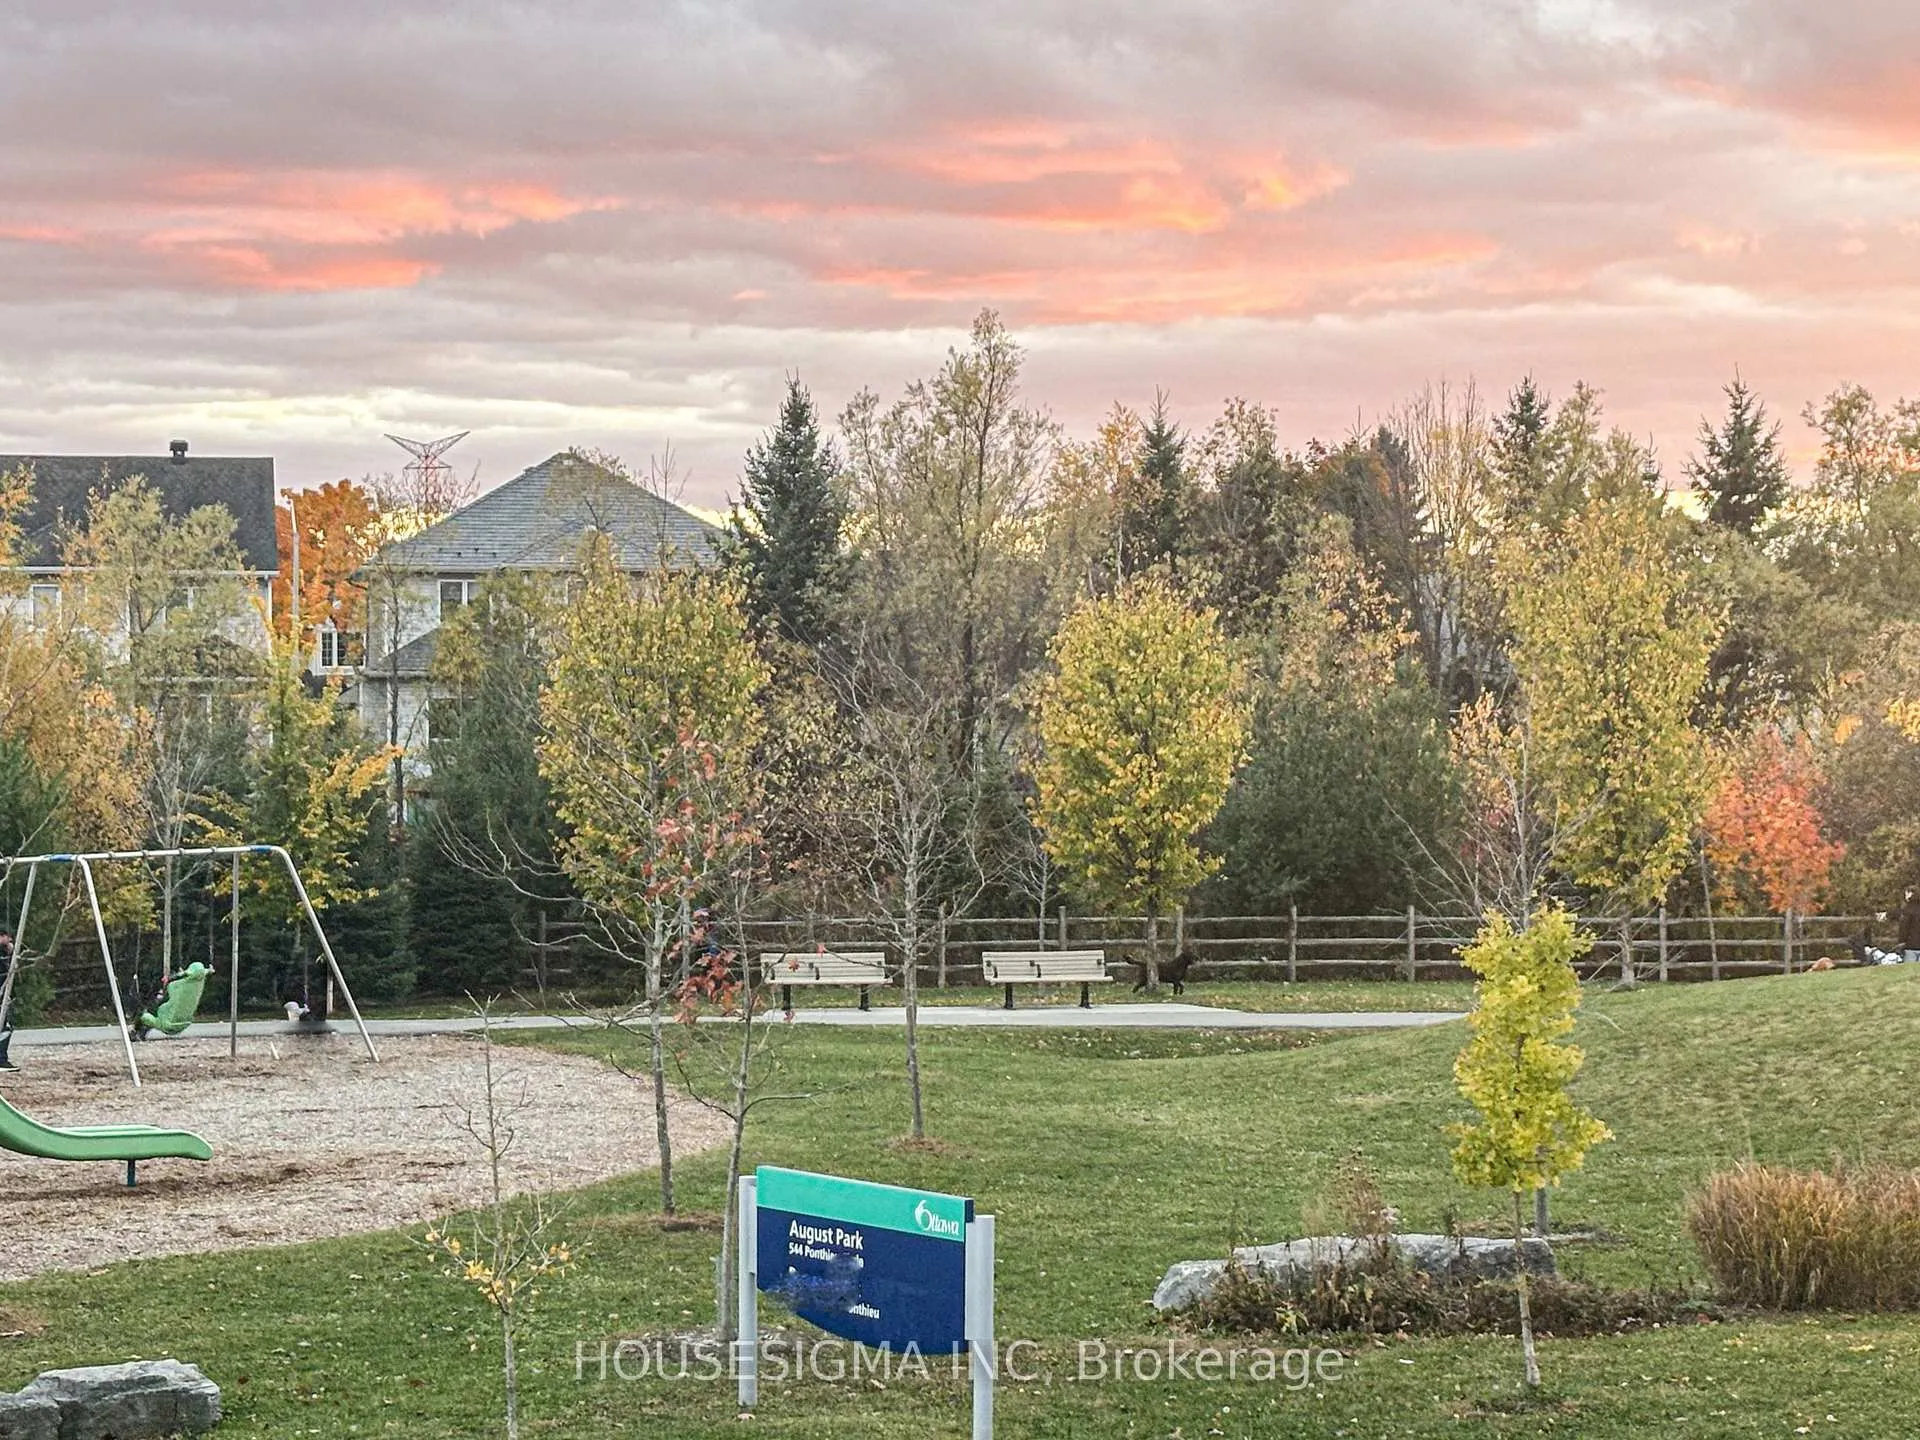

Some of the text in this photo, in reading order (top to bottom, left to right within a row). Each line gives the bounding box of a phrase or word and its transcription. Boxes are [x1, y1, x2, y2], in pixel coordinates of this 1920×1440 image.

[914, 1200, 960, 1236] Ottawa
[789, 1219, 864, 1250] August Park
[789, 1242, 804, 1256] 544
